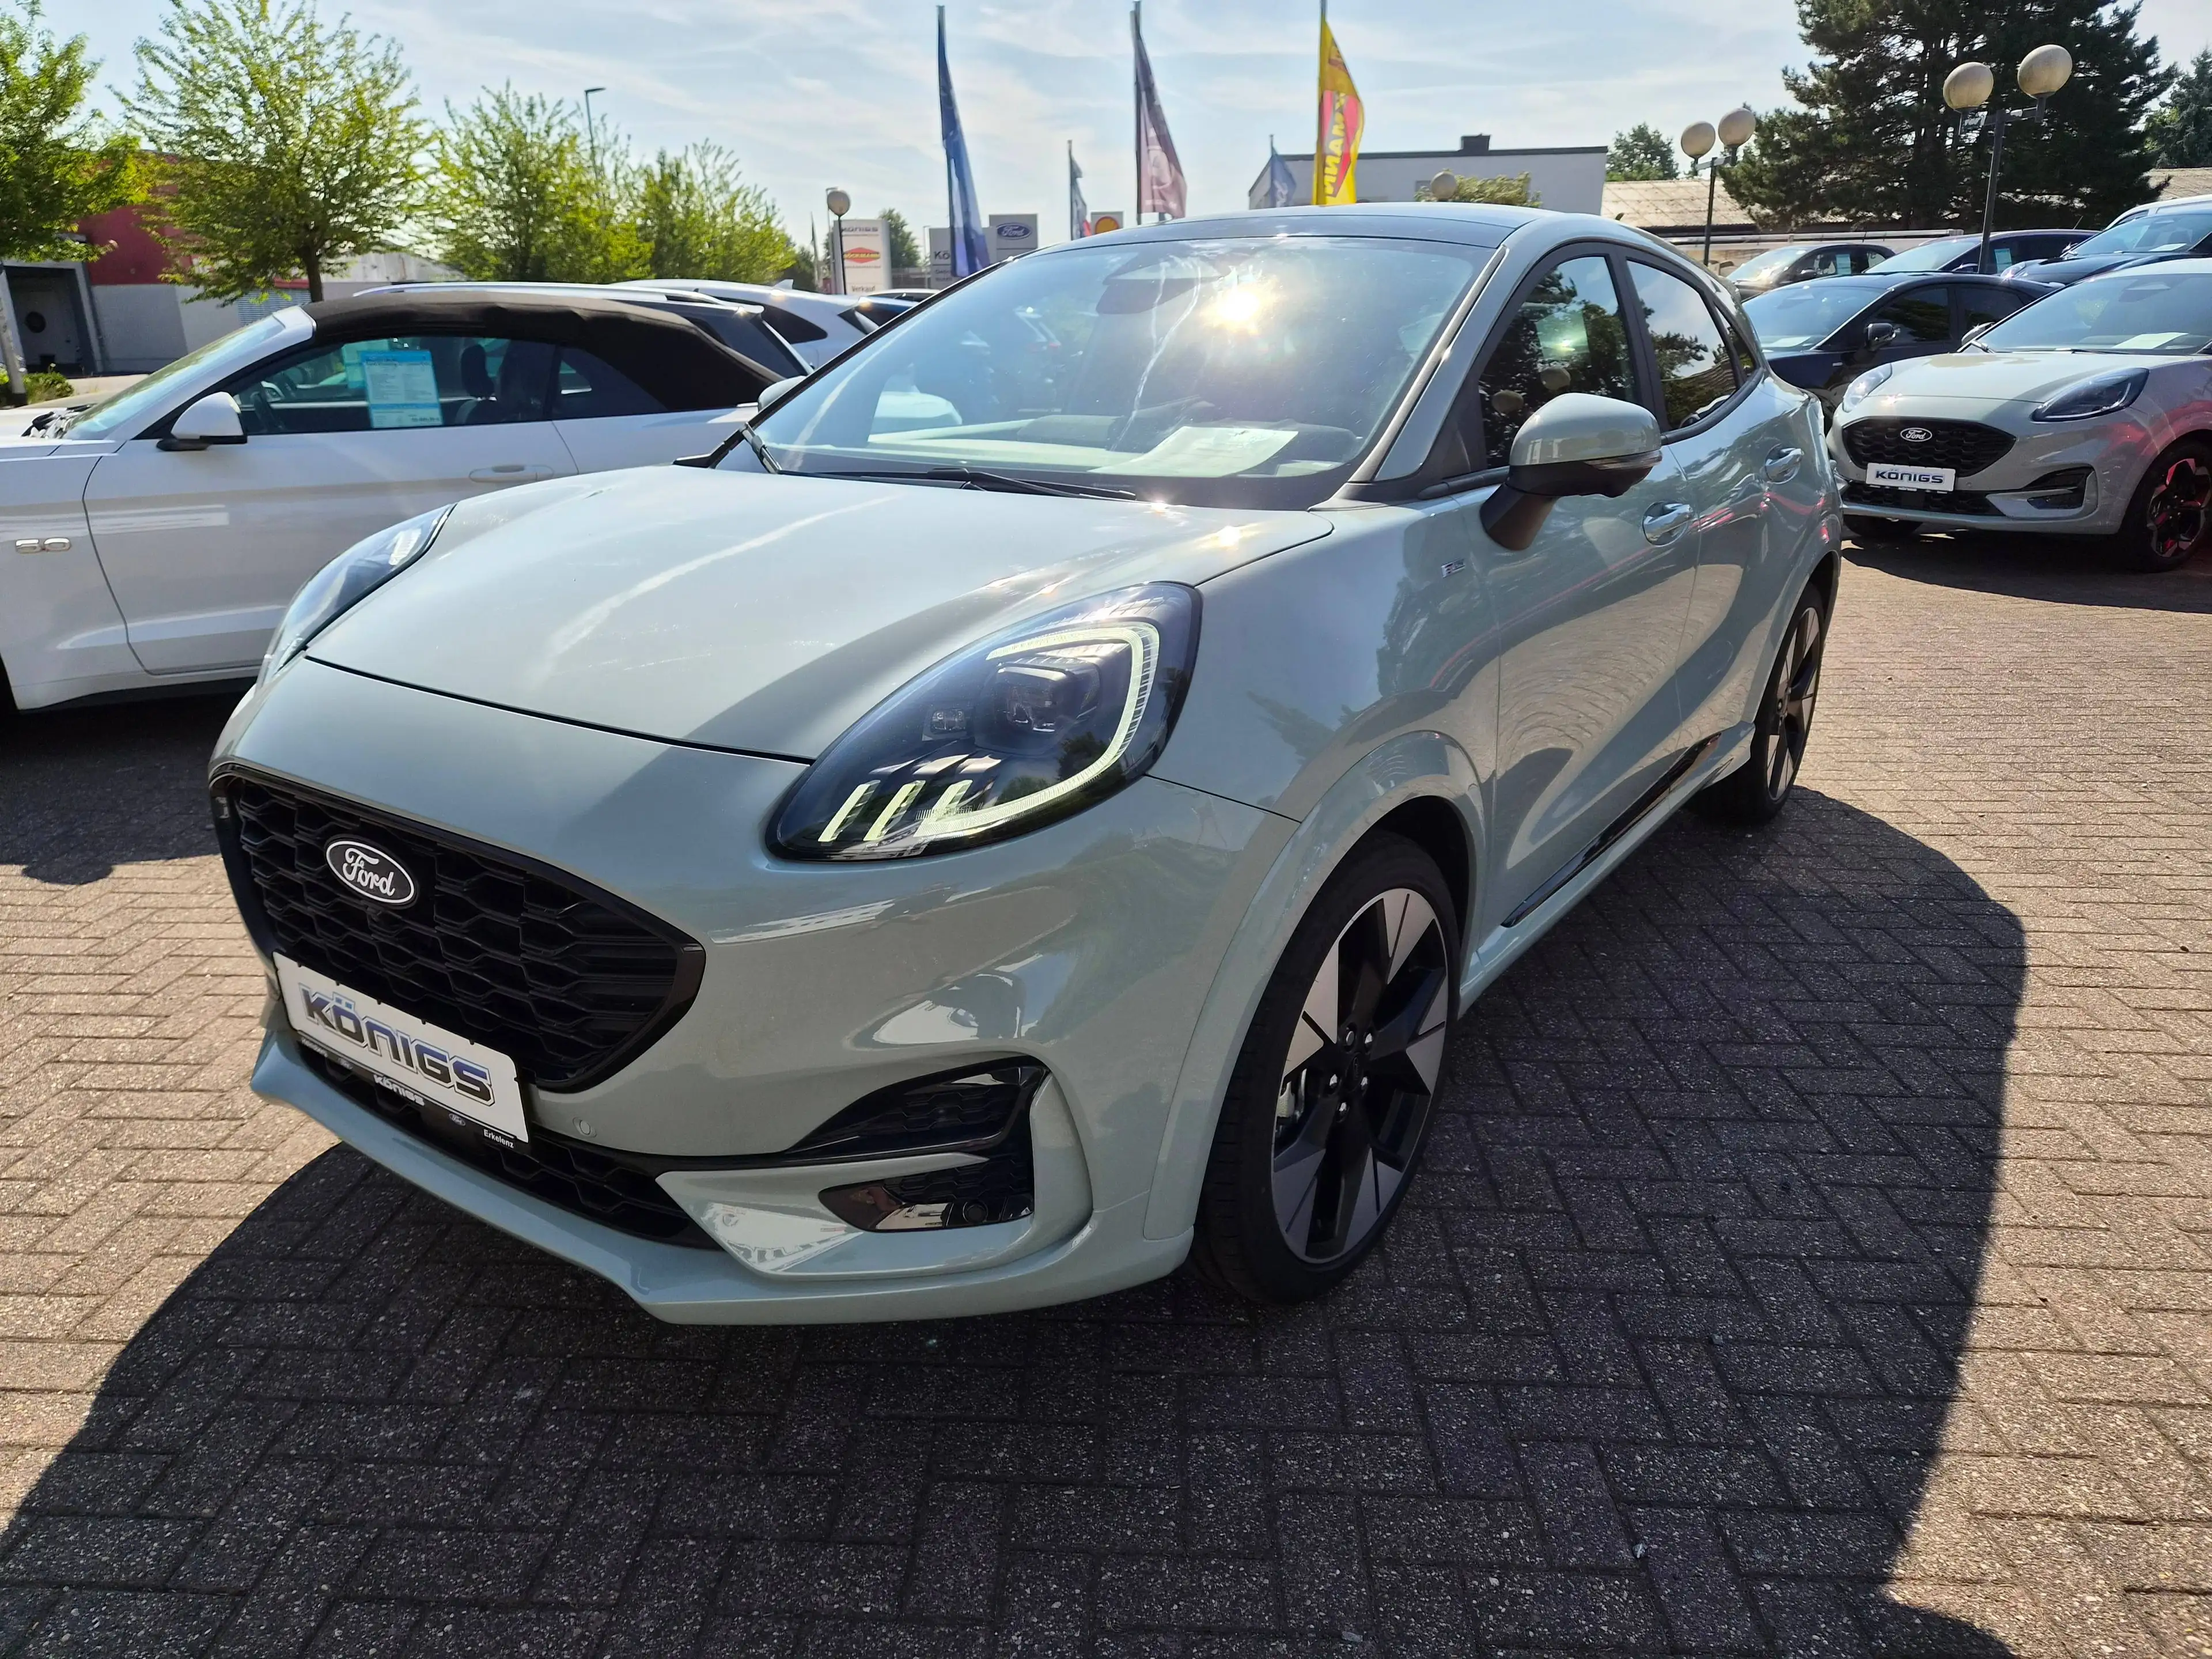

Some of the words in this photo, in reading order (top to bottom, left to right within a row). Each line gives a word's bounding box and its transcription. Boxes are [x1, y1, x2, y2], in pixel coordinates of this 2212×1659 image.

[1906, 429, 1925, 440] Ford
[1875, 468, 1944, 484] KÖNIGS
[342, 847, 396, 896] Ford
[299, 983, 495, 1107] KÖNIGS
[483, 1128, 514, 1149] Erkelenz
